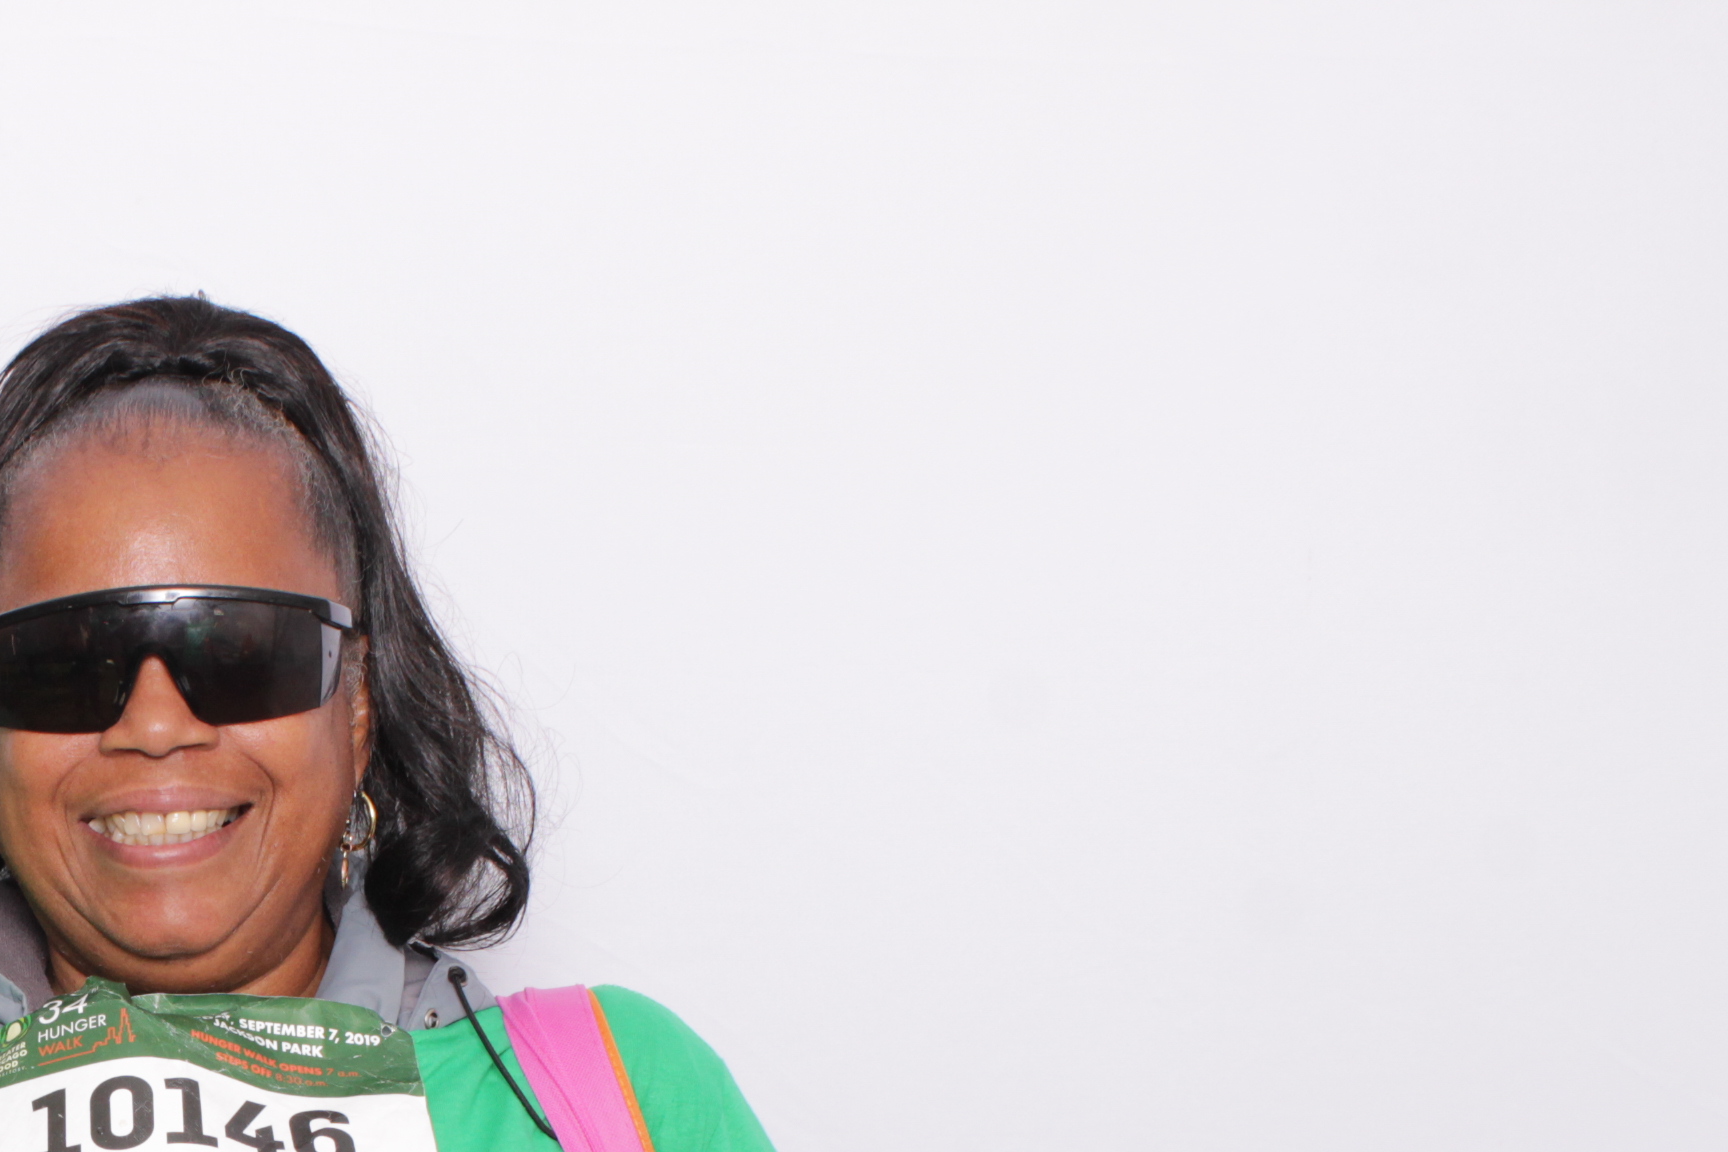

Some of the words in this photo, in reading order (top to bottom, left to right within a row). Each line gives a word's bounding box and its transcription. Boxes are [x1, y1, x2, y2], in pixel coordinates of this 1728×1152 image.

[37, 1014, 107, 1043] HUNGER
[213, 1019, 278, 1050] JACKSON
[281, 1041, 324, 1058] PARK
[239, 1018, 325, 1039] SEPTEMBER
[328, 1028, 340, 1044] 7,
[345, 1031, 381, 1047] 2019
[38, 1035, 84, 1057] WALK
[190, 1029, 242, 1053] HUNGER
[243, 1048, 277, 1068] WALK
[279, 1062, 323, 1076] OPENS
[326, 1068, 335, 1076] 7
[338, 1070, 361, 1078] a.m.
[215, 1052, 249, 1070] STEPS
[251, 1064, 273, 1077] OFF
[275, 1073, 302, 1085] 8:30
